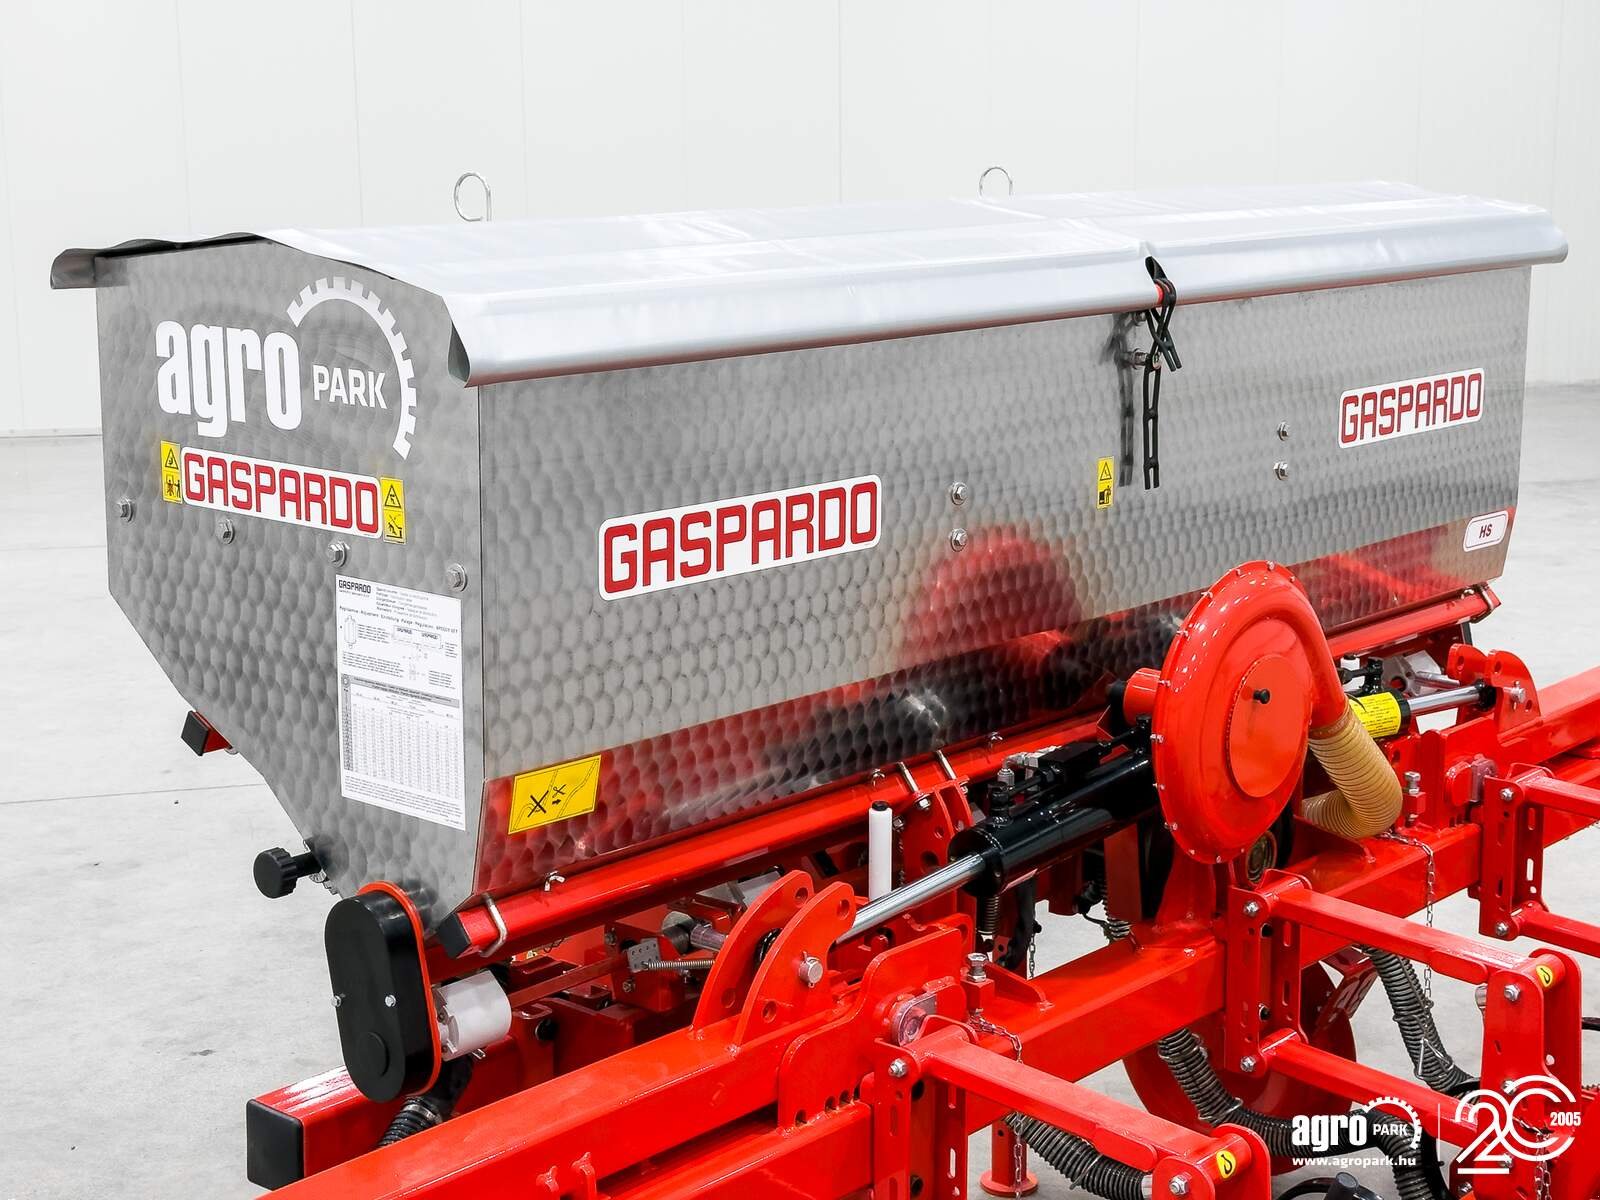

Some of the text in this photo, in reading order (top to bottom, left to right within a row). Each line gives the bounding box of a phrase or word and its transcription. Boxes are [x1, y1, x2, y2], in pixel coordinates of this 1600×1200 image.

[155, 320, 388, 438] agro PARK
[1341, 372, 1482, 444] GASPARDO
[183, 452, 379, 534] GASPARDO
[1478, 523, 1493, 539] HS
[603, 481, 878, 594] GASPARDO
[338, 579, 371, 594] GASPARDO
